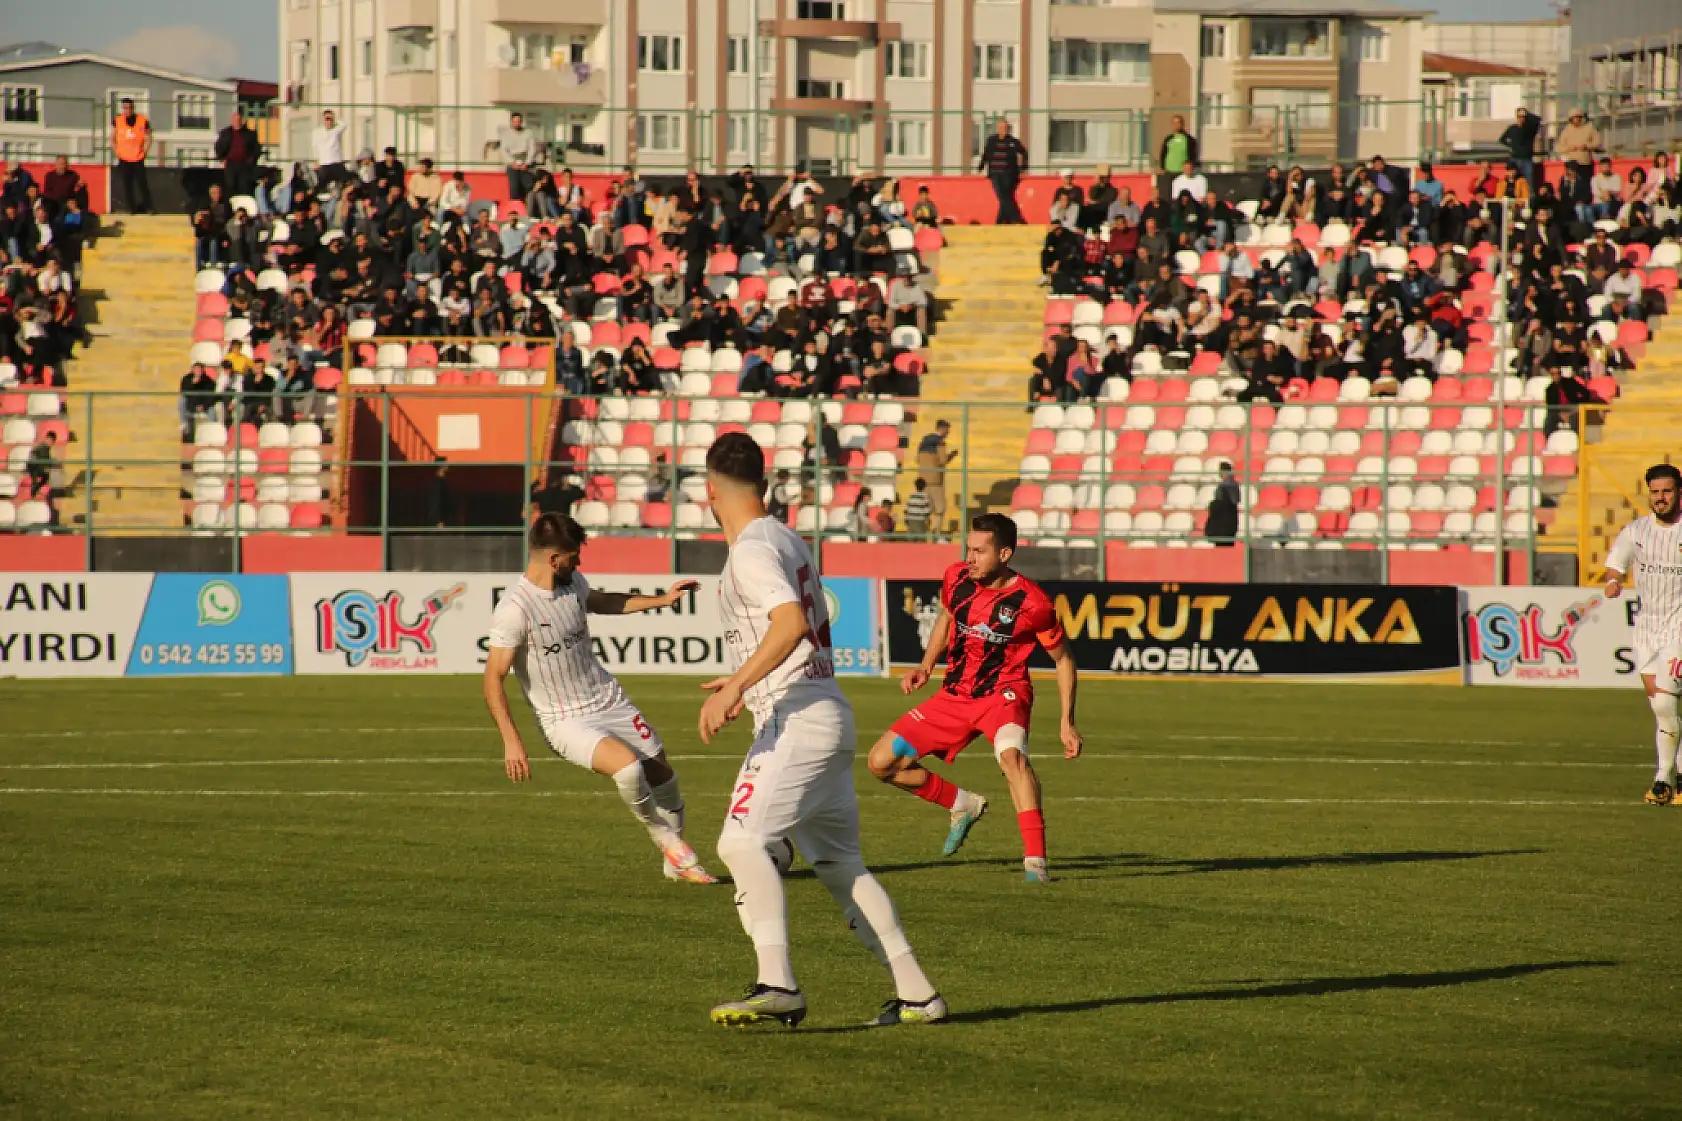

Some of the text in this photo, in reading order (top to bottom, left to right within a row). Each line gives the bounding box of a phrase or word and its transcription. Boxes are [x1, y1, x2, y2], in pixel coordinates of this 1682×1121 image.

[0, 582, 86, 611] ANI
[1054, 583, 1231, 641] MRÜT
[1243, 596, 1423, 644] ANKA
[141, 643, 284, 664] 0 542 425 55 99
[369, 657, 438, 668] REKLAM
[1111, 642, 1260, 672] MOBİLYA
[1516, 668, 1580, 680] REKLAM
[632, 713, 652, 740] 5
